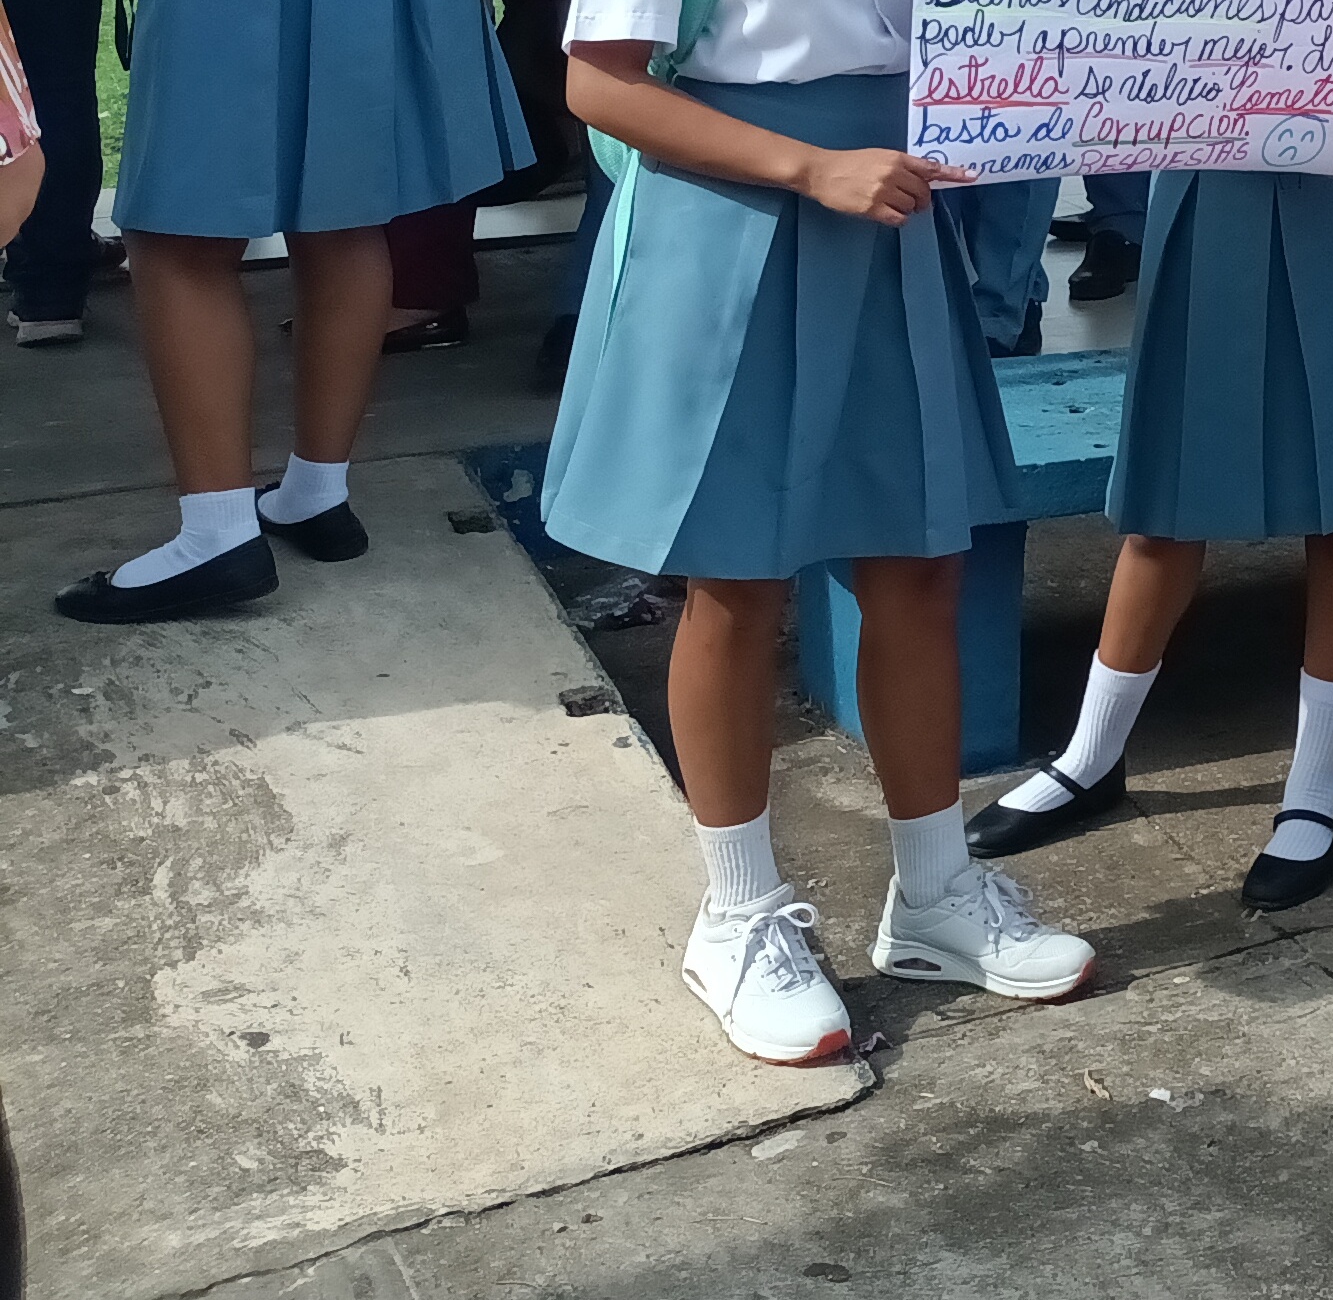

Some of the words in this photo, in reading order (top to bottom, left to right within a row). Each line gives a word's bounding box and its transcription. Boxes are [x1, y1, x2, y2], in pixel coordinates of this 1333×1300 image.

[915, 8, 1026, 68] poder
[1032, 20, 1192, 79] aprender
[916, 54, 1070, 102] estrella
[913, 105, 1021, 147] basta
[1026, 106, 1074, 144] de
